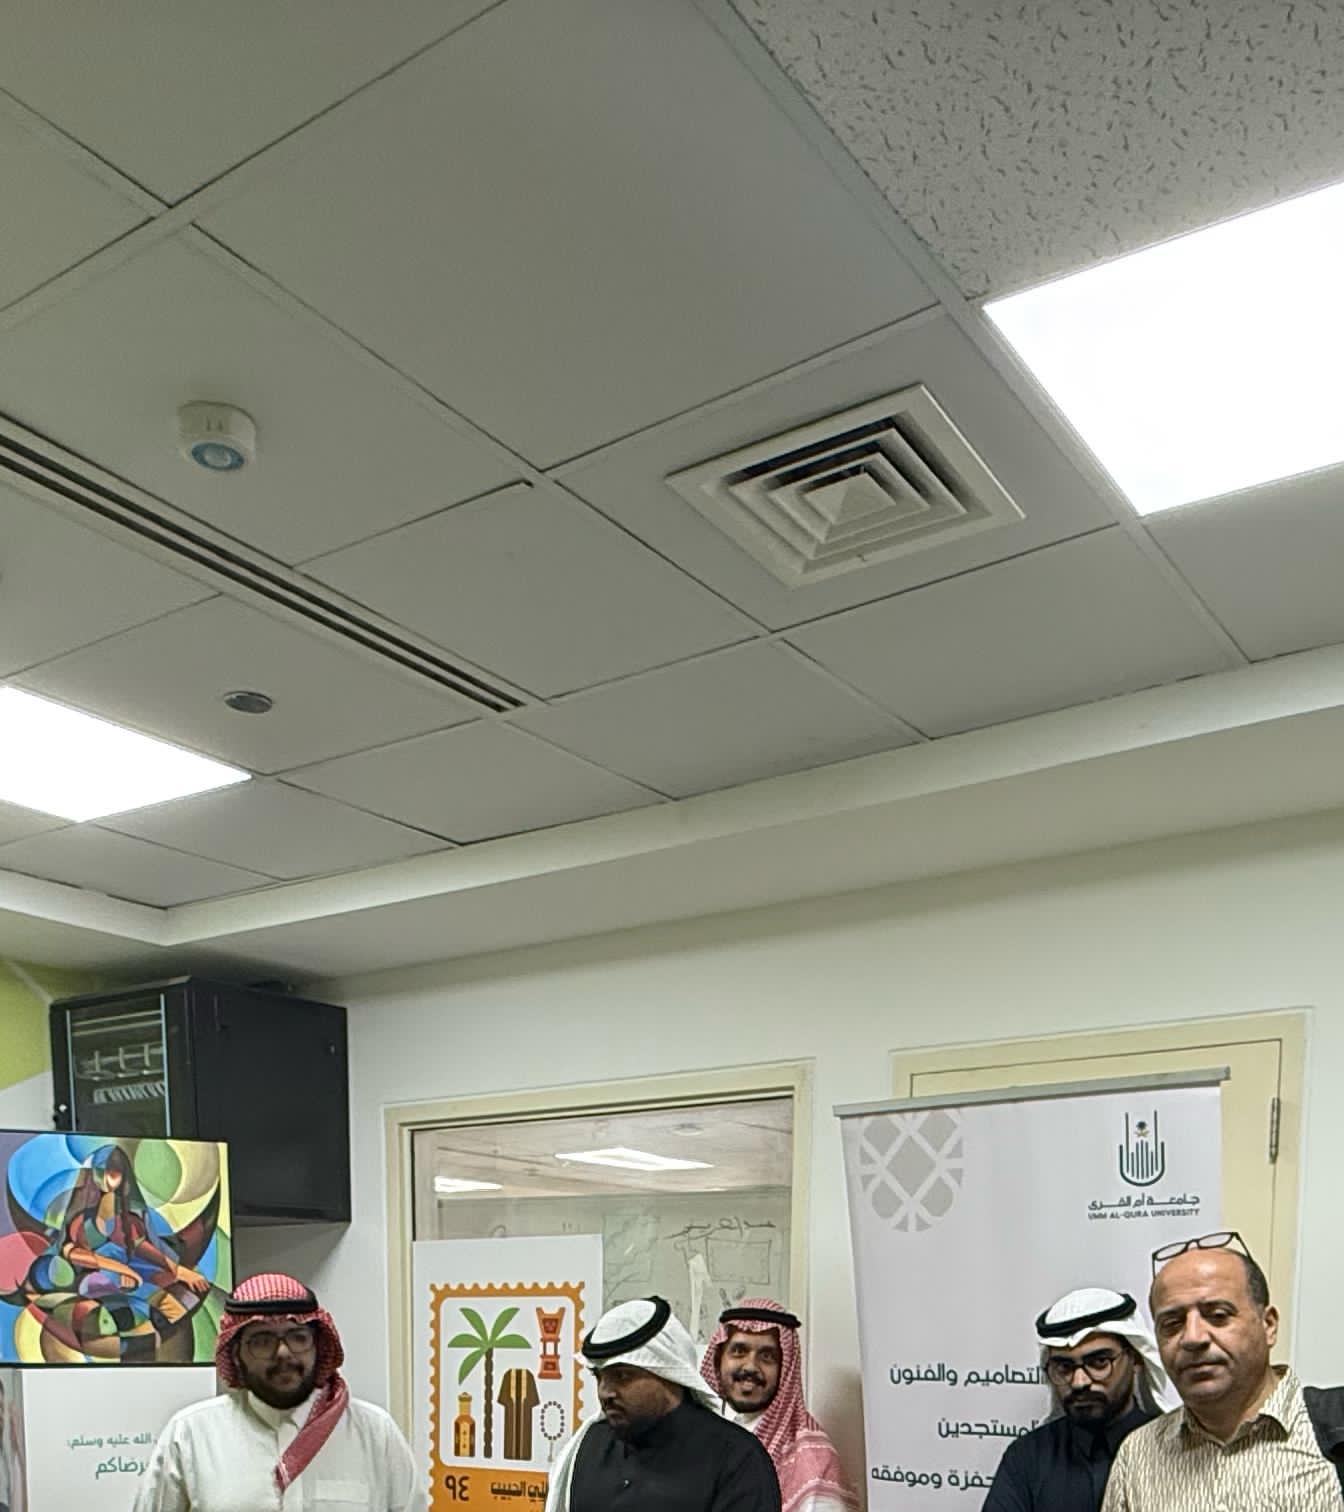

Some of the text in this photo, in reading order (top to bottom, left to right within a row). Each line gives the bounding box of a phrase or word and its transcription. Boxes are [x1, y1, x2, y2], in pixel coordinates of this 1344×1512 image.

[1147, 1192, 1200, 1207] جامعة
[1087, 1208, 1200, 1220] UMM AL-QURA UNIVERSITY
[890, 1363, 958, 1386] والفنون
[133, 1432, 153, 1446] الله
[937, 1418, 1039, 1439] لمستجدين
[107, 1433, 131, 1448] عليه
[95, 1455, 147, 1480] رضاكم
[444, 1474, 470, 1501] ٩٤
[947, 1468, 996, 1490] حفزة
